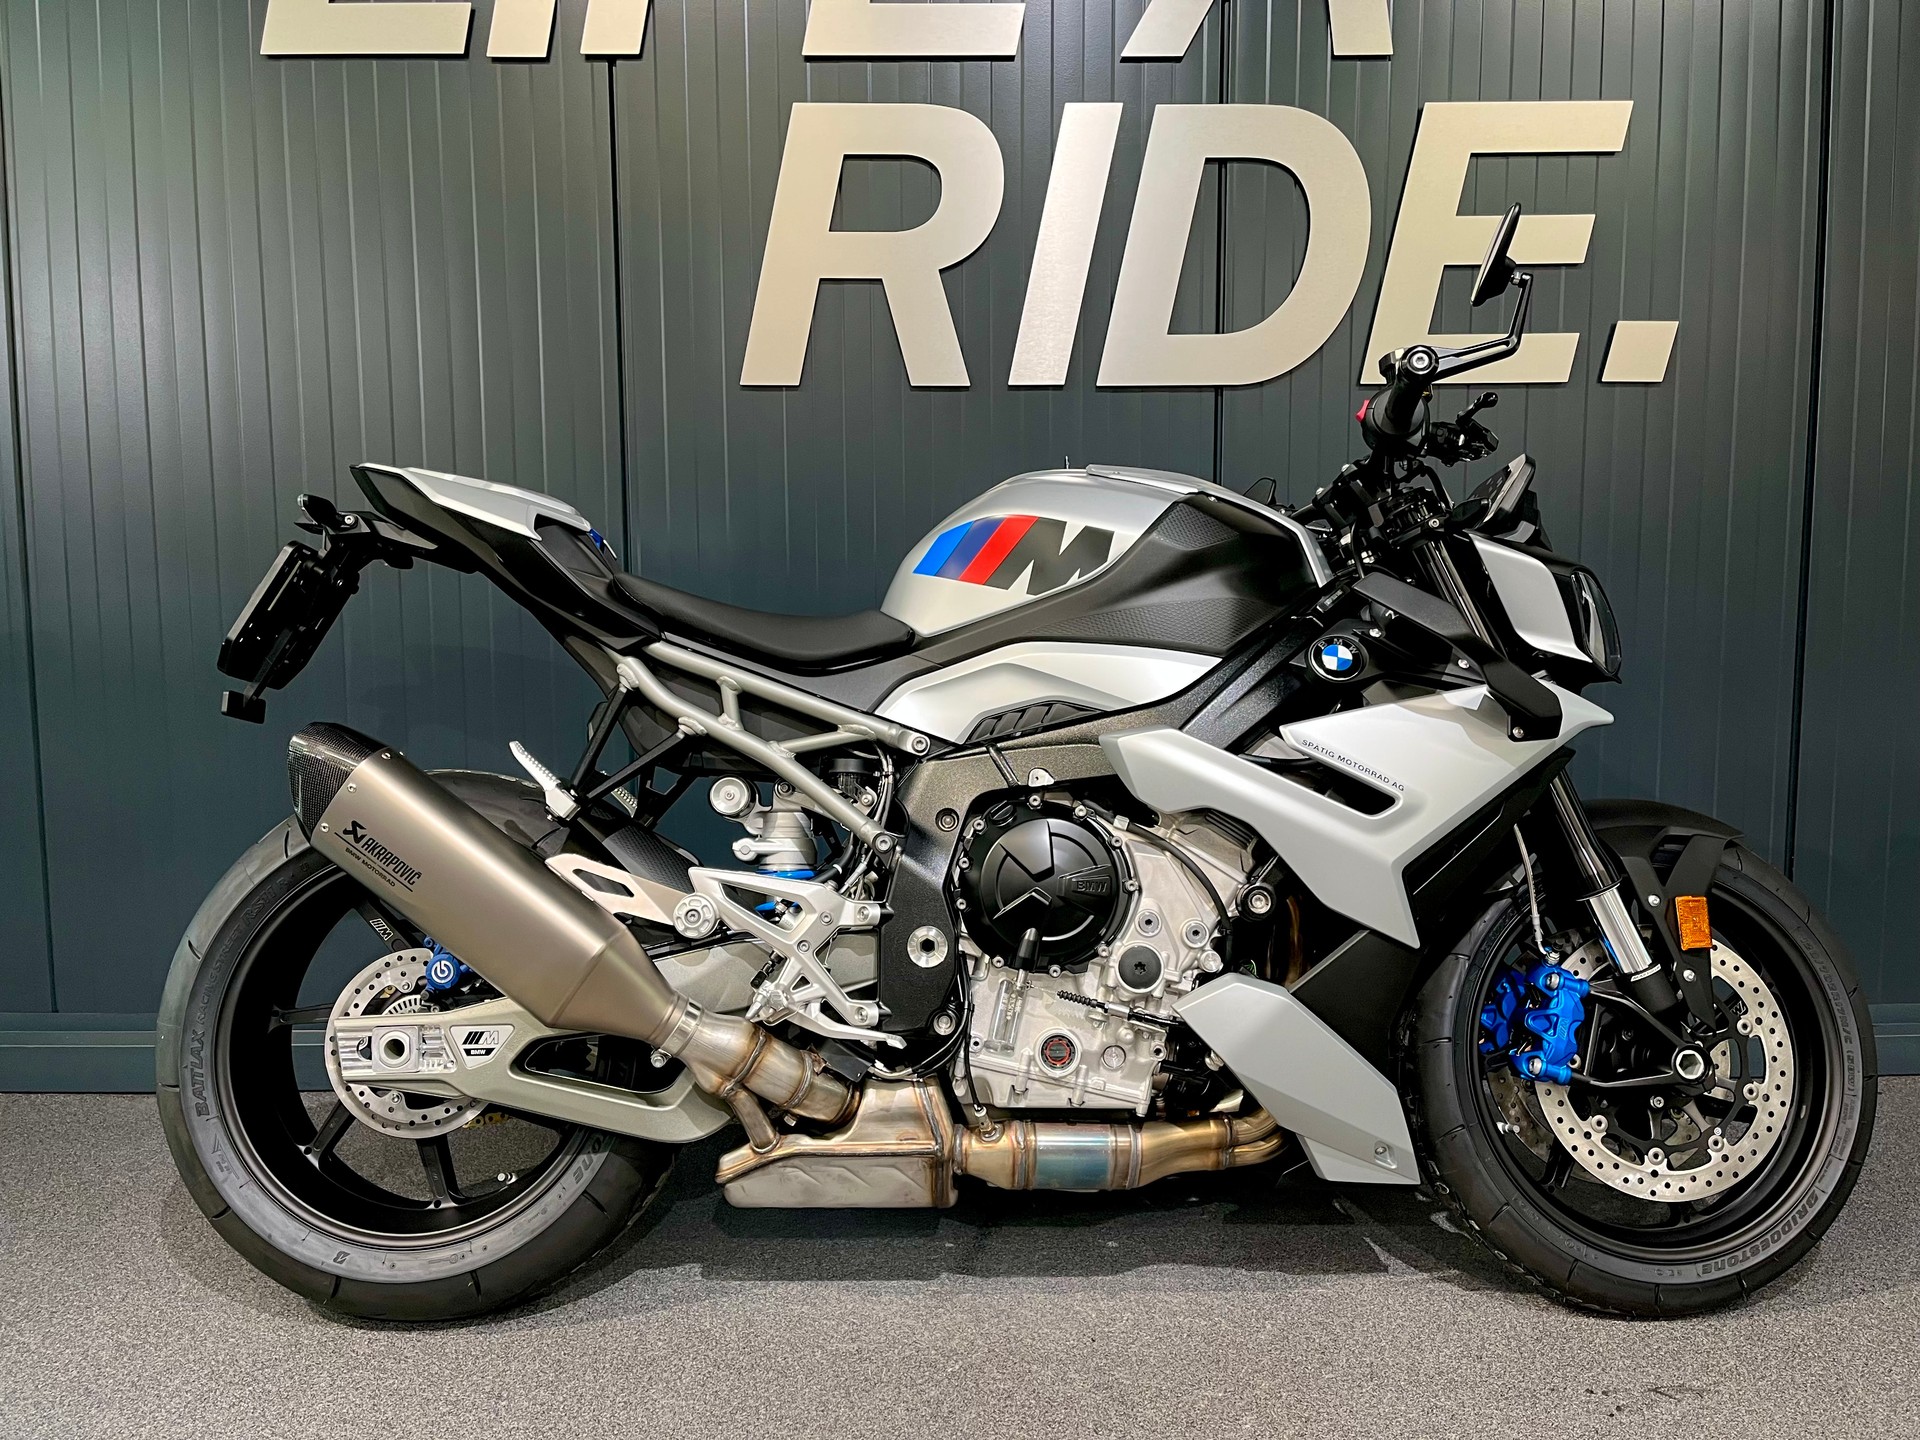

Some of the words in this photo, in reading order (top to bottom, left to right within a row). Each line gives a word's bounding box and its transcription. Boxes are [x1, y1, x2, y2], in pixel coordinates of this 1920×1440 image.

[740, 100, 1680, 388] RIDE.
[1318, 638, 1360, 655] BMW
[1337, 754, 1391, 784] MOTORRAD
[1391, 780, 1406, 792] AG
[344, 846, 362, 861] BMW
[361, 858, 396, 887] MOTORRAD
[1077, 880, 1108, 893] BMW
[190, 1028, 210, 1117] BATTLAX
